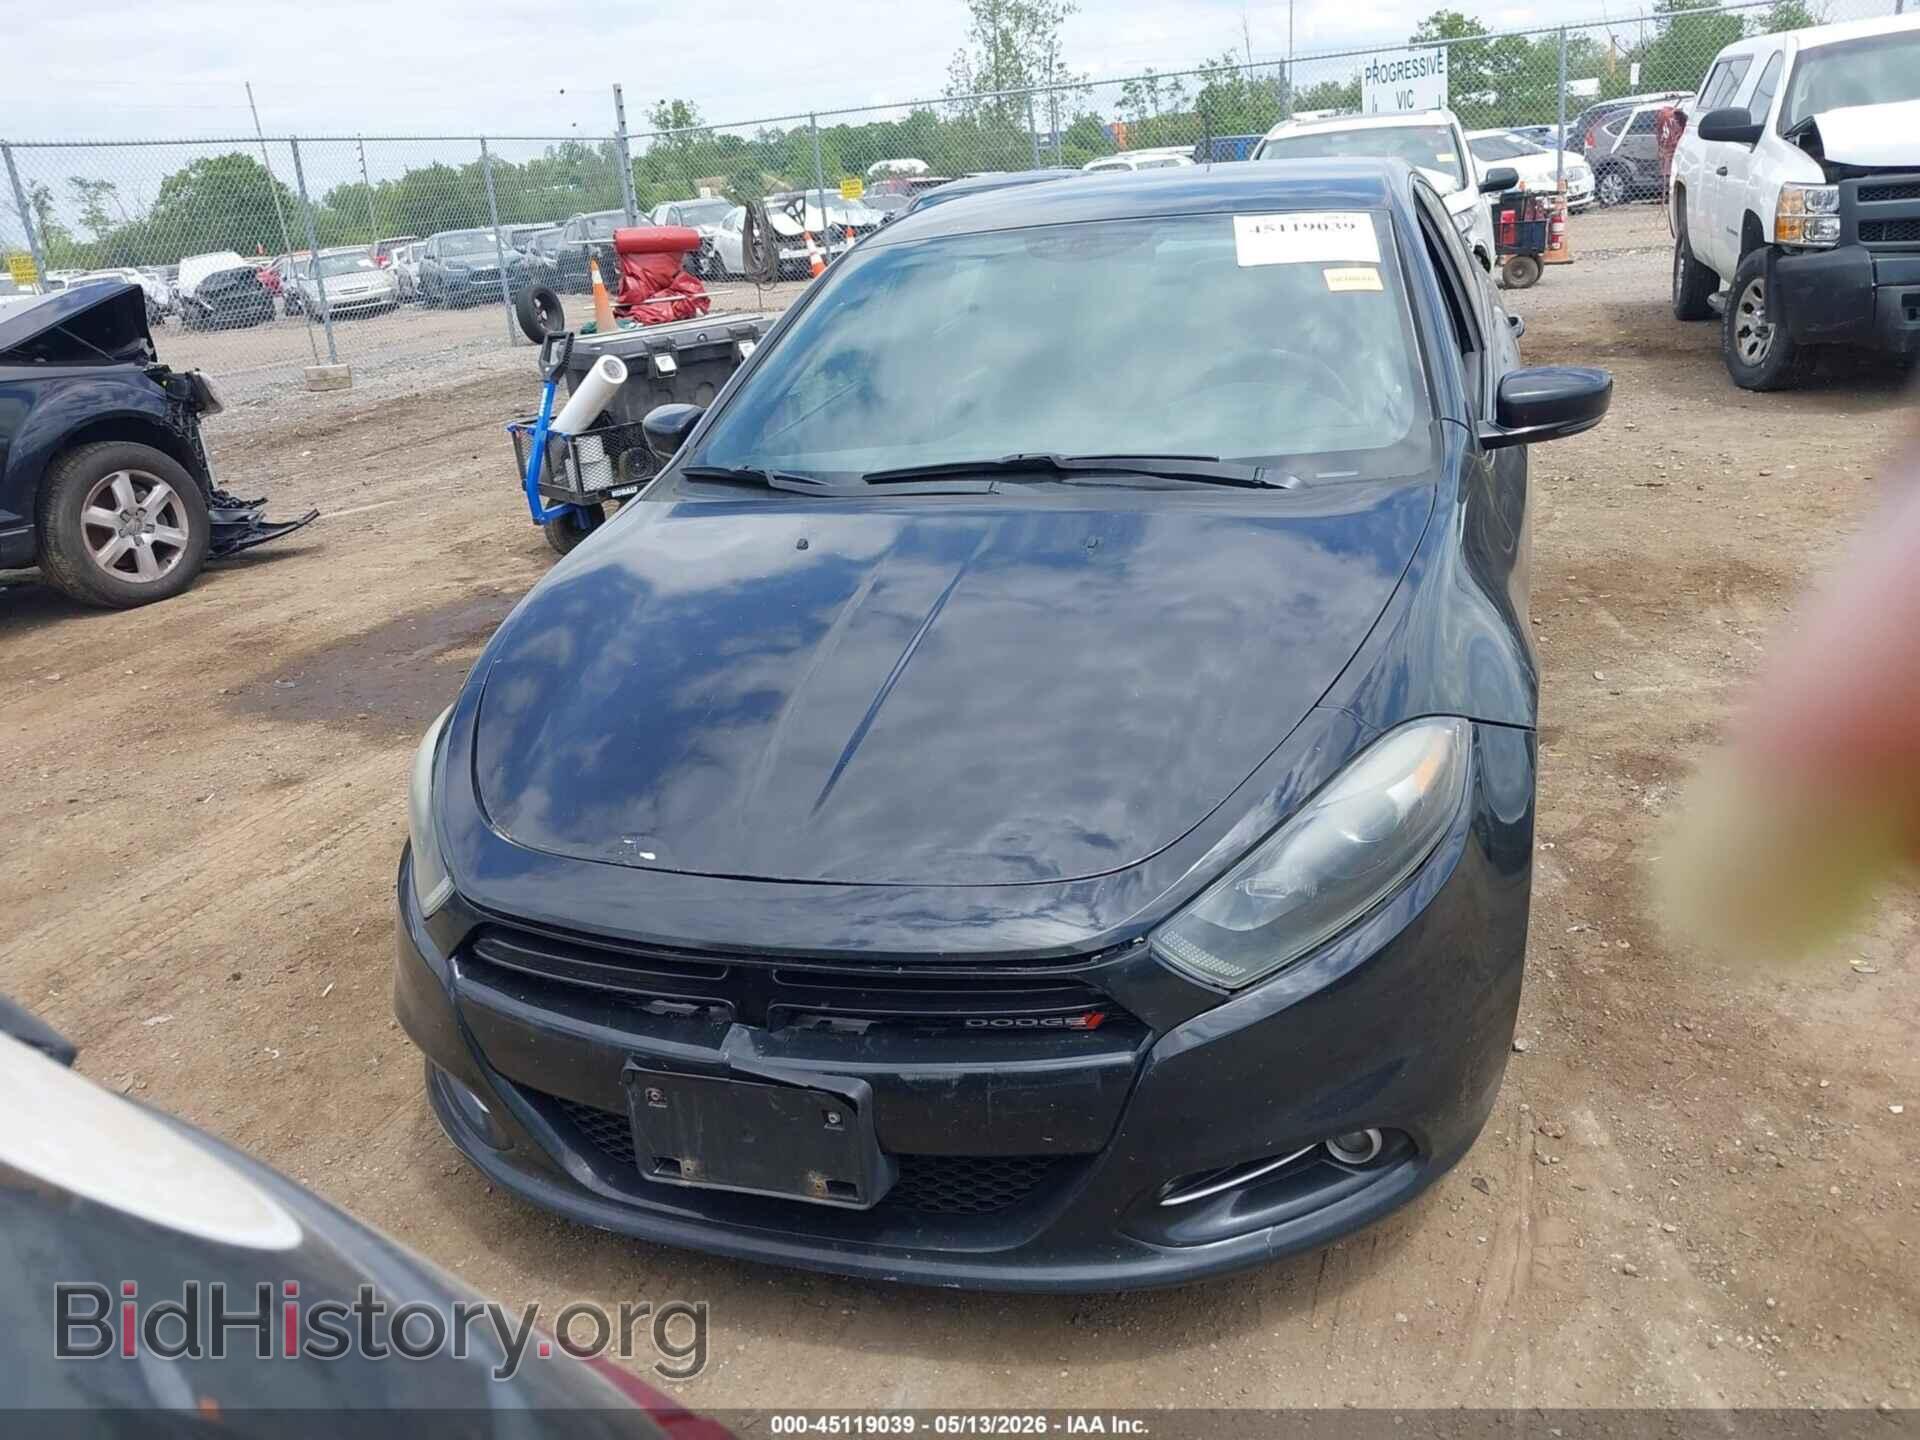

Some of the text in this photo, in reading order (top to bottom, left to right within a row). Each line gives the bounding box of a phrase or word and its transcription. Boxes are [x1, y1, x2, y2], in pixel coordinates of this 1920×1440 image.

[1365, 55, 1444, 87] PROGRESSIVE
[1396, 89, 1415, 110] VIC
[966, 1017, 1087, 1029] DODGE
